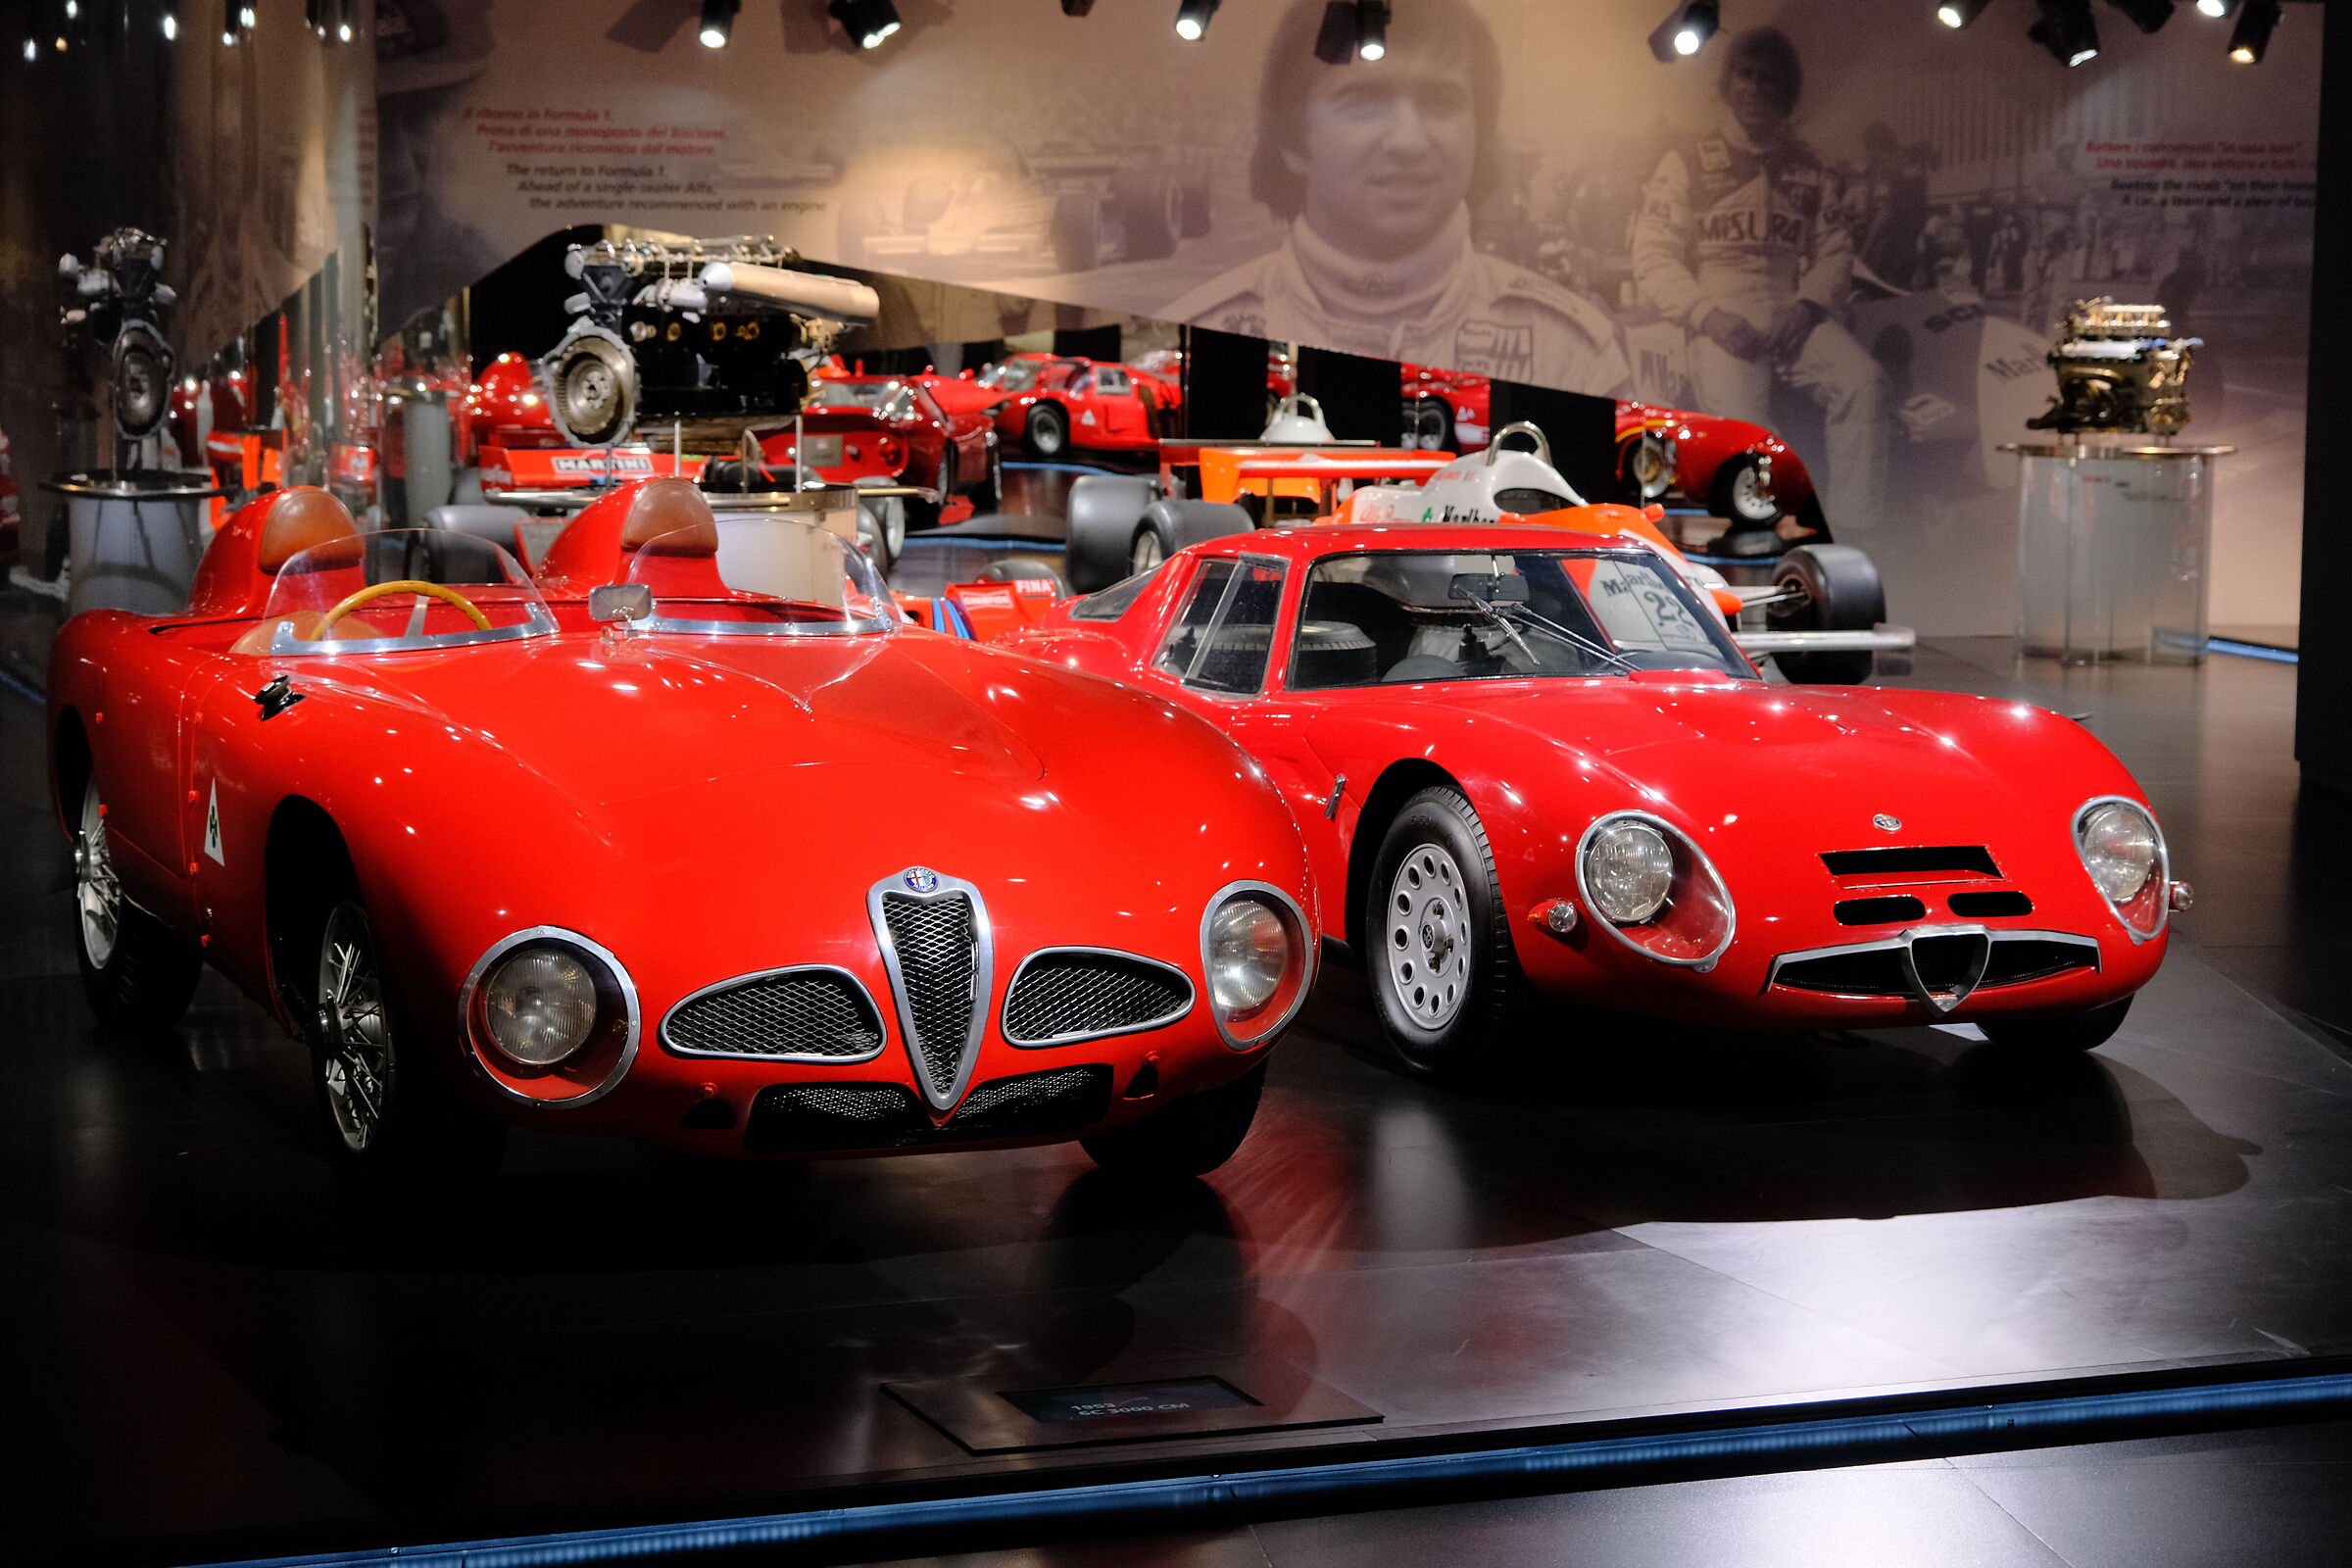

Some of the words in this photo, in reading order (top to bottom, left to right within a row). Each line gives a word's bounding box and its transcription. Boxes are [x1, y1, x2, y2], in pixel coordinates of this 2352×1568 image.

[507, 163, 529, 175] The
[534, 164, 577, 176] return
[580, 165, 595, 176] to
[598, 165, 654, 177] Formula
[517, 180, 563, 192] Ahead
[565, 180, 581, 193] of
[529, 197, 552, 209] the
[556, 198, 625, 210] adventure
[628, 199, 724, 212] recommenced
[726, 199, 757, 211] with
[760, 201, 778, 212] an
[781, 201, 827, 215] engine
[556, 458, 651, 471] MARTINI
[1015, 579, 1052, 593] FINA
[1107, 1405, 1153, 1414] 3000
